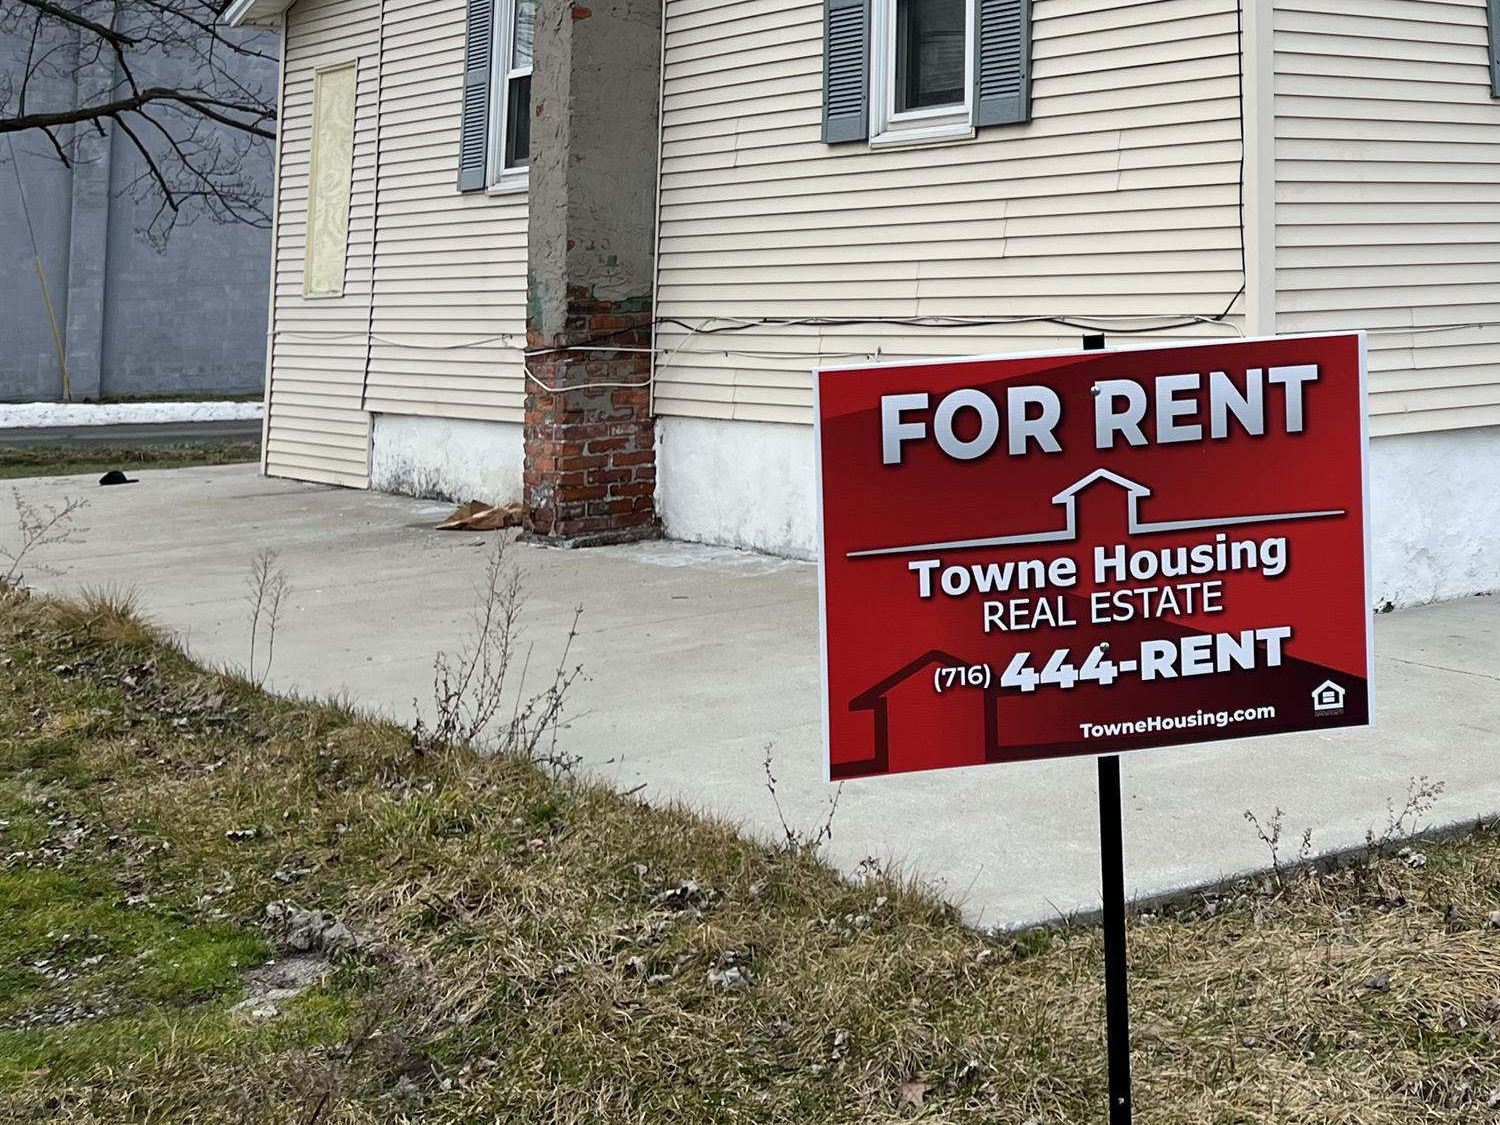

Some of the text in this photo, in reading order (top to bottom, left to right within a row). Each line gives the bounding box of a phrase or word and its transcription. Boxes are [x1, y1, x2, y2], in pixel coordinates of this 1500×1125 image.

[881, 364, 1318, 464] FOR RENT
[908, 533, 1287, 598] Towne Housing
[983, 580, 1223, 633] REAL ESTATE
[933, 625, 1291, 693] (716) 444-RENT
[1079, 706, 1276, 739] TowneHousing.com
